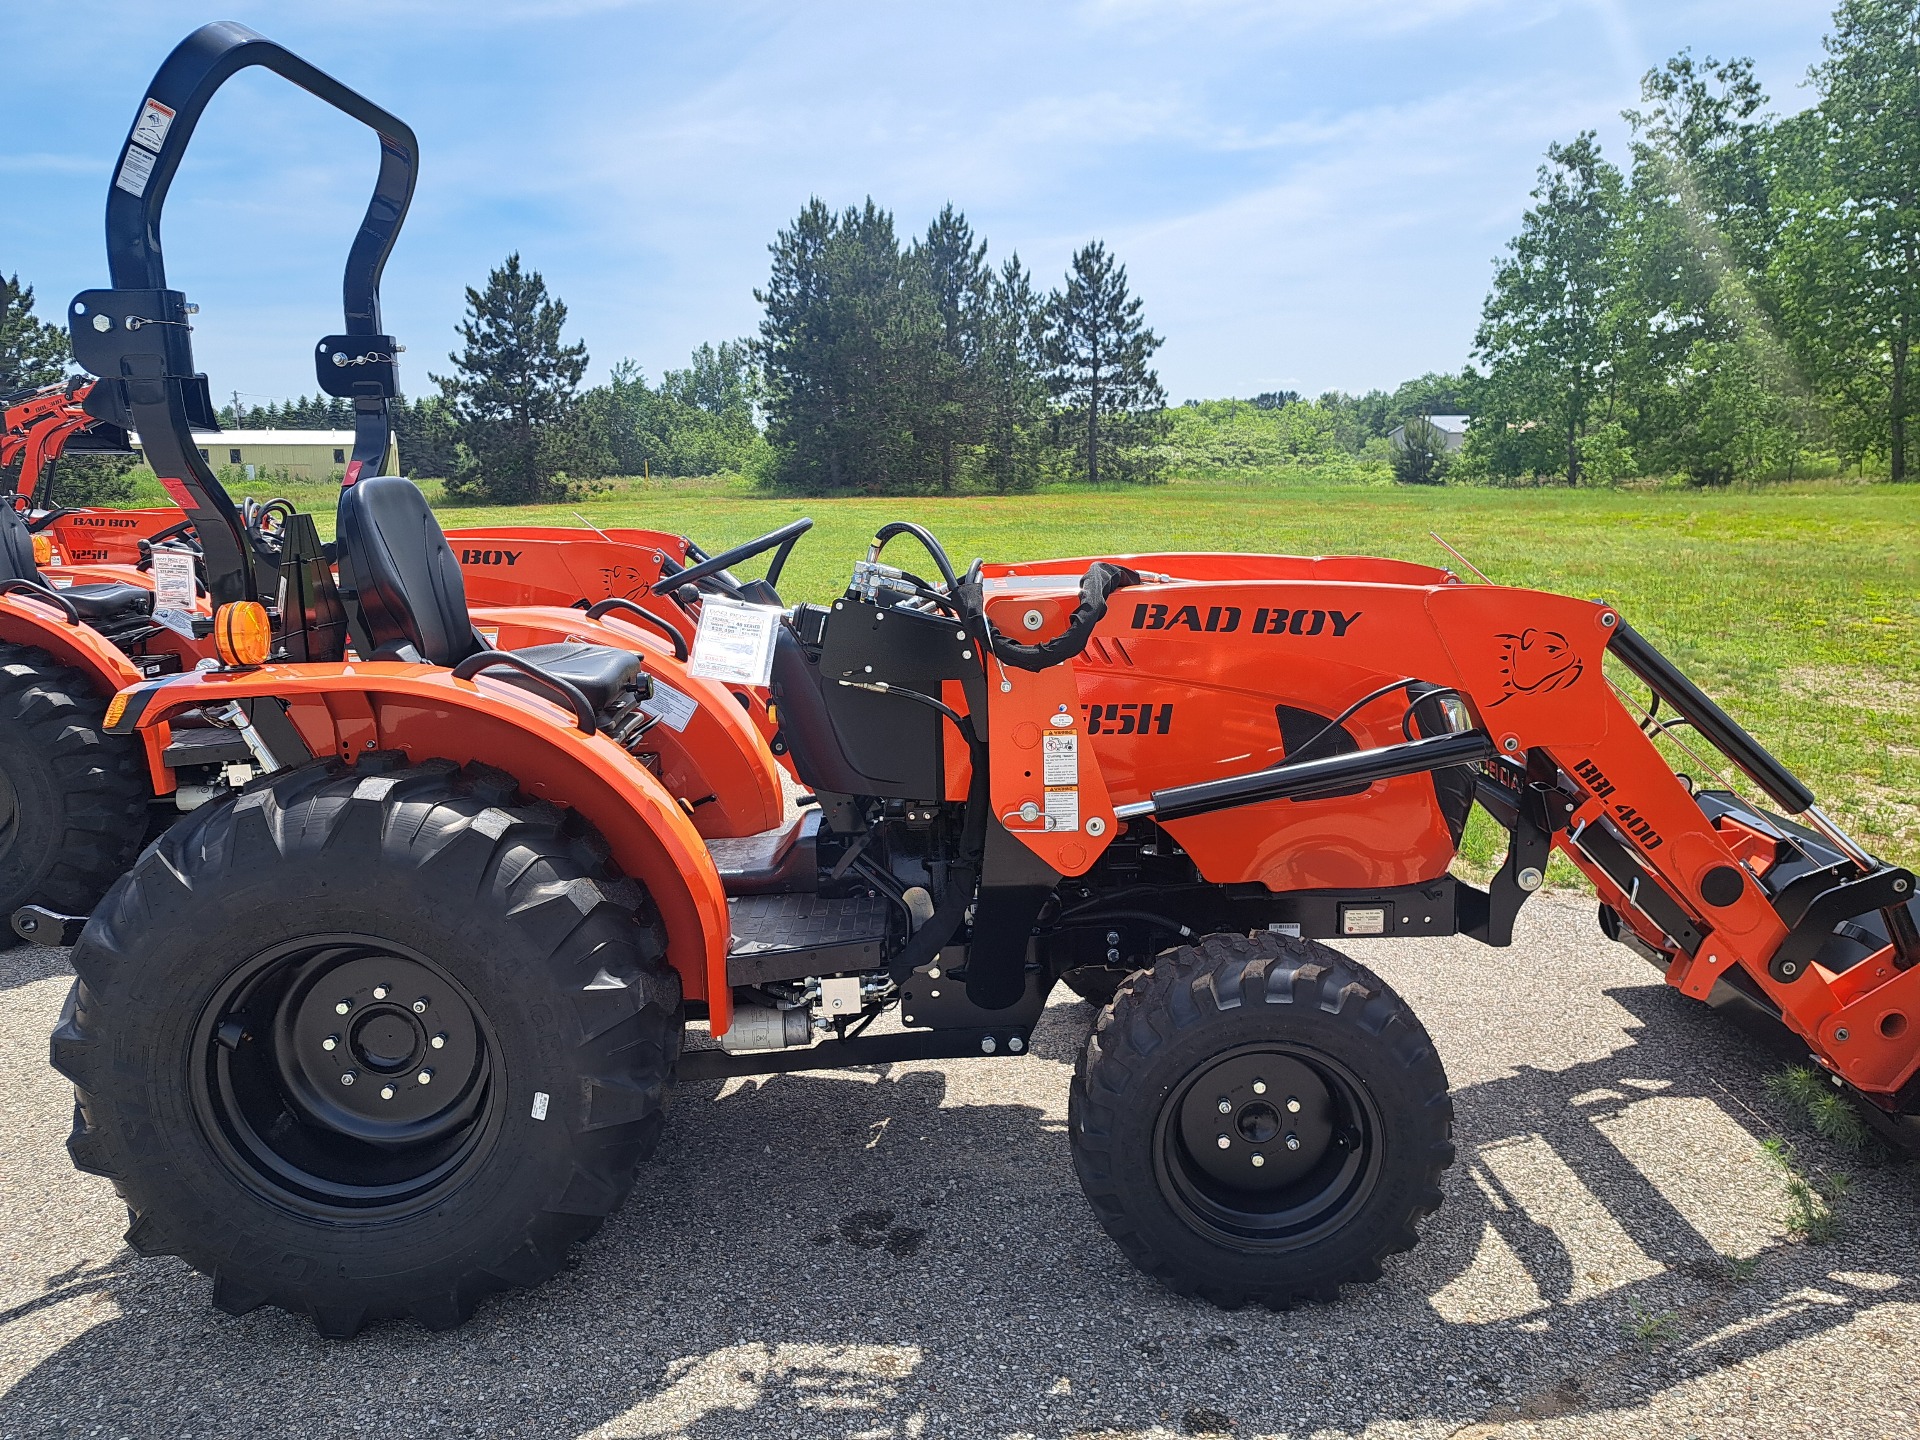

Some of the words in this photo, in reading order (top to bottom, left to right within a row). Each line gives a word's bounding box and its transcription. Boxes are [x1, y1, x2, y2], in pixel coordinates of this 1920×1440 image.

[73, 517, 105, 527] BAD
[108, 518, 140, 528] BOY
[461, 549, 523, 566] BOY
[1130, 603, 1242, 633] BAD
[1251, 608, 1363, 637] BOY
[1573, 758, 1616, 805] BBL
[1615, 804, 1663, 850] 400
